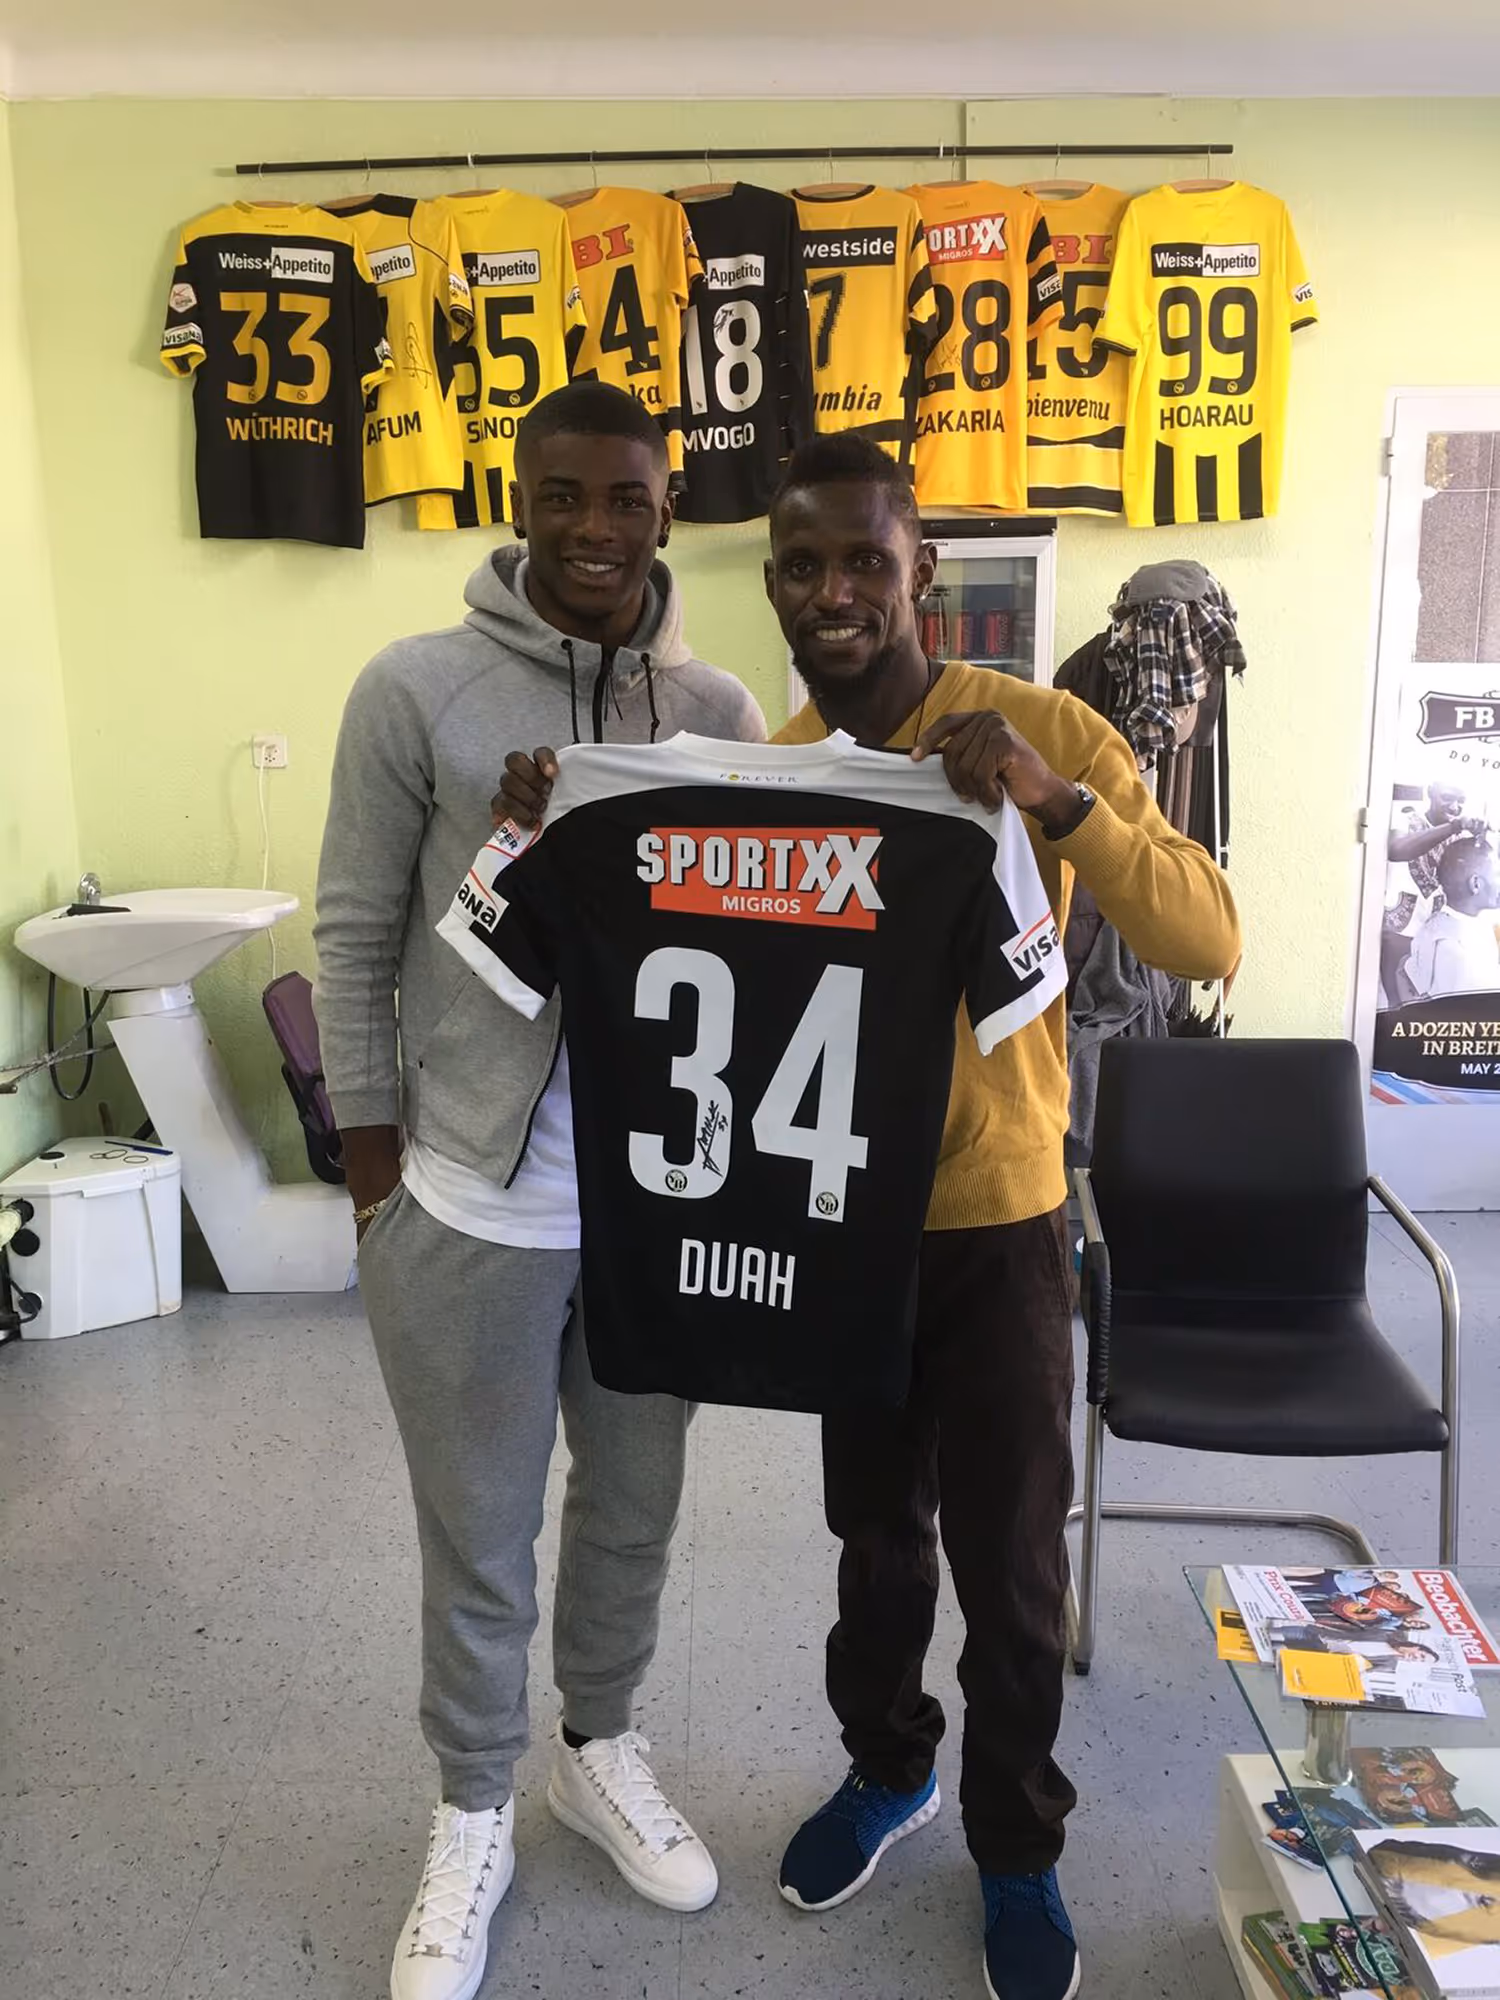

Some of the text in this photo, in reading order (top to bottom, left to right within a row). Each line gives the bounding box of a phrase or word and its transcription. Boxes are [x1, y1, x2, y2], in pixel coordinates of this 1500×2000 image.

[803, 237, 895, 259] westside
[925, 216, 1008, 254] ORTXX
[938, 248, 973, 261] MIGROS
[219, 291, 331, 404] 33
[915, 279, 1011, 397] 28
[1158, 286, 1258, 397] 99
[682, 300, 764, 415] 18
[1160, 404, 1254, 430] HOARAU
[682, 422, 755, 453] MVOGO
[722, 895, 801, 914] MIGROS
[1391, 1022, 1406, 1037] A
[1408, 1022, 1477, 1037] DOZEN
[1422, 1040, 1444, 1056] IN
[629, 946, 869, 1223] 34
[1461, 1063, 1491, 1075] MAY
[679, 1238, 796, 1311] DUAH
[1419, 1573, 1489, 1662] Beobachter
